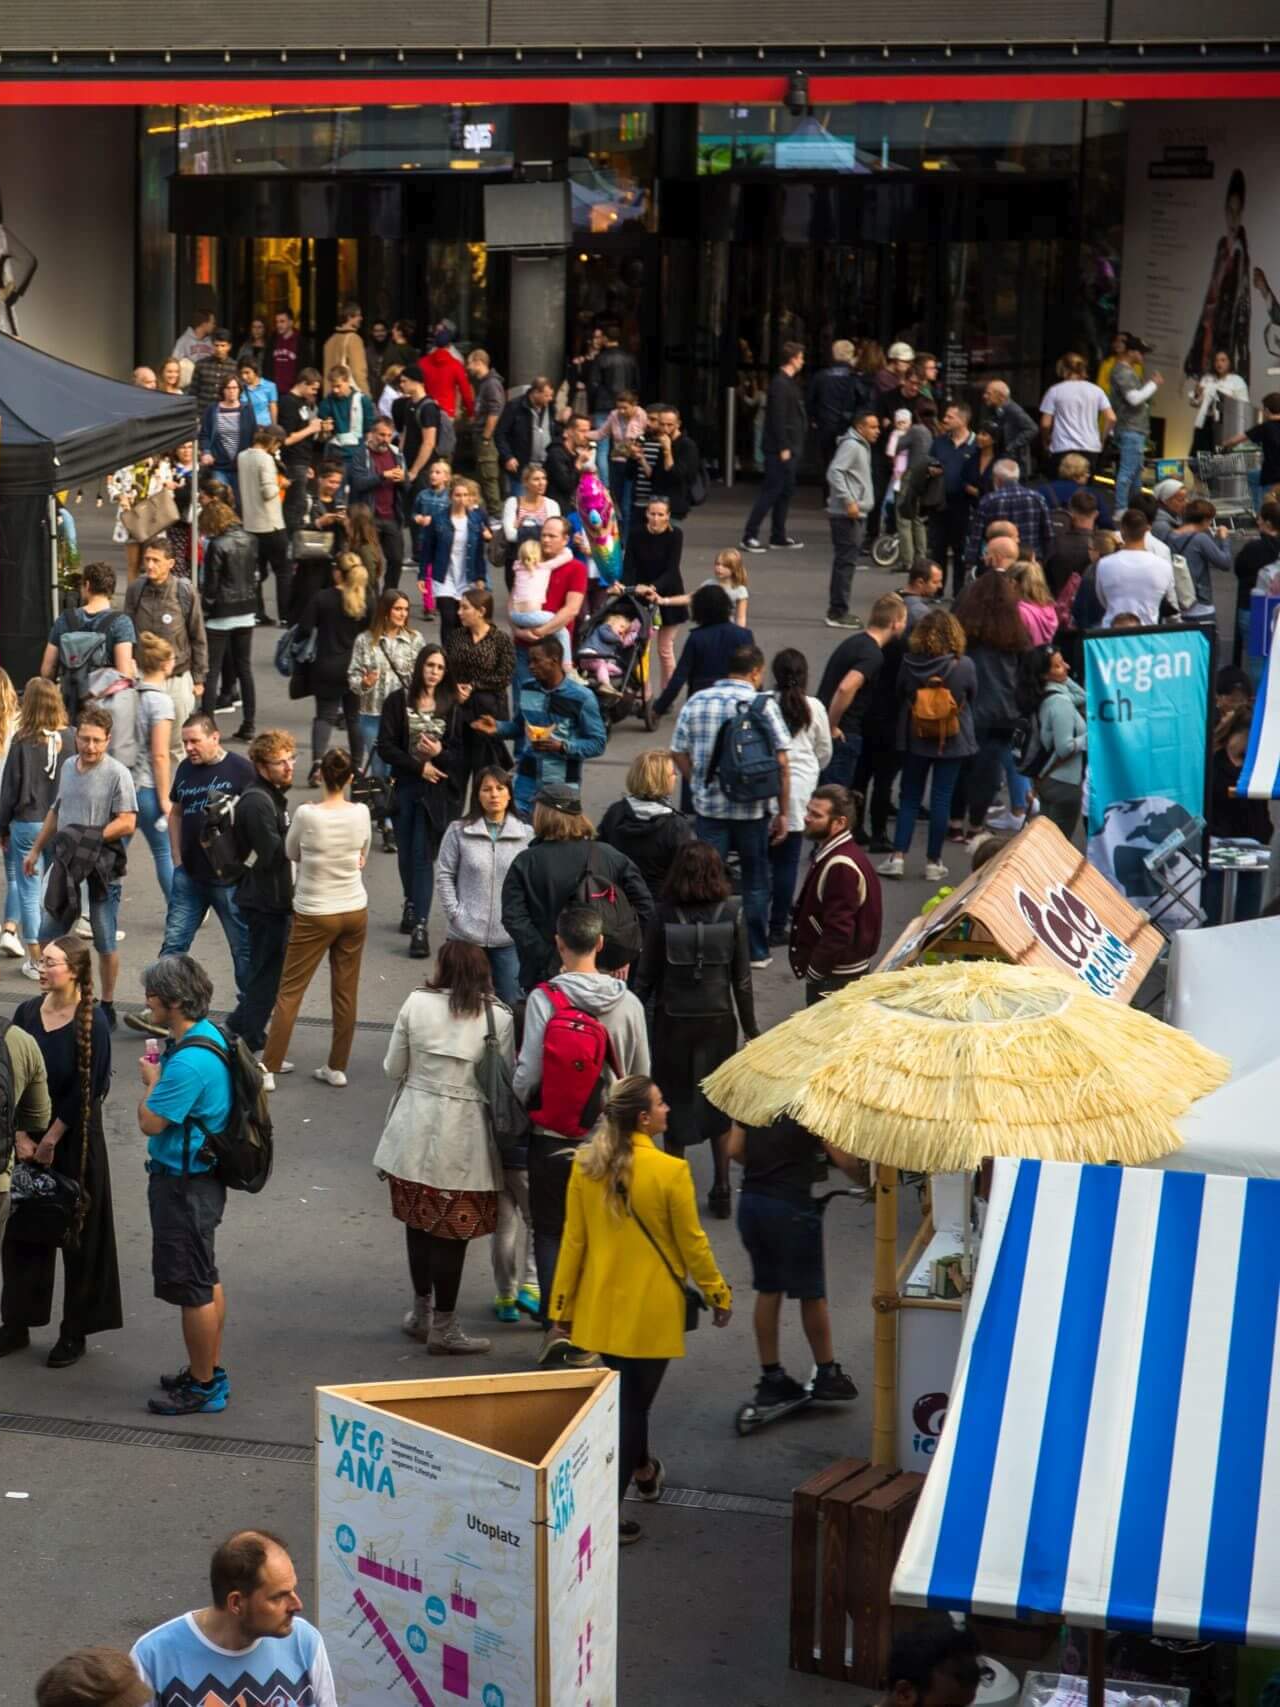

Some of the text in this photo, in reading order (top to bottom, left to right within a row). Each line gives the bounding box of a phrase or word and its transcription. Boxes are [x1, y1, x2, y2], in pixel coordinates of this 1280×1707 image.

[1099, 650, 1192, 693] vegan
[1091, 689, 1133, 723] .ch
[330, 1414, 385, 1462] VEG
[335, 1449, 396, 1499] ANA
[550, 1458, 571, 1510] VEG
[466, 1512, 521, 1548] Utoplatz
[552, 1488, 576, 1543] ANA
